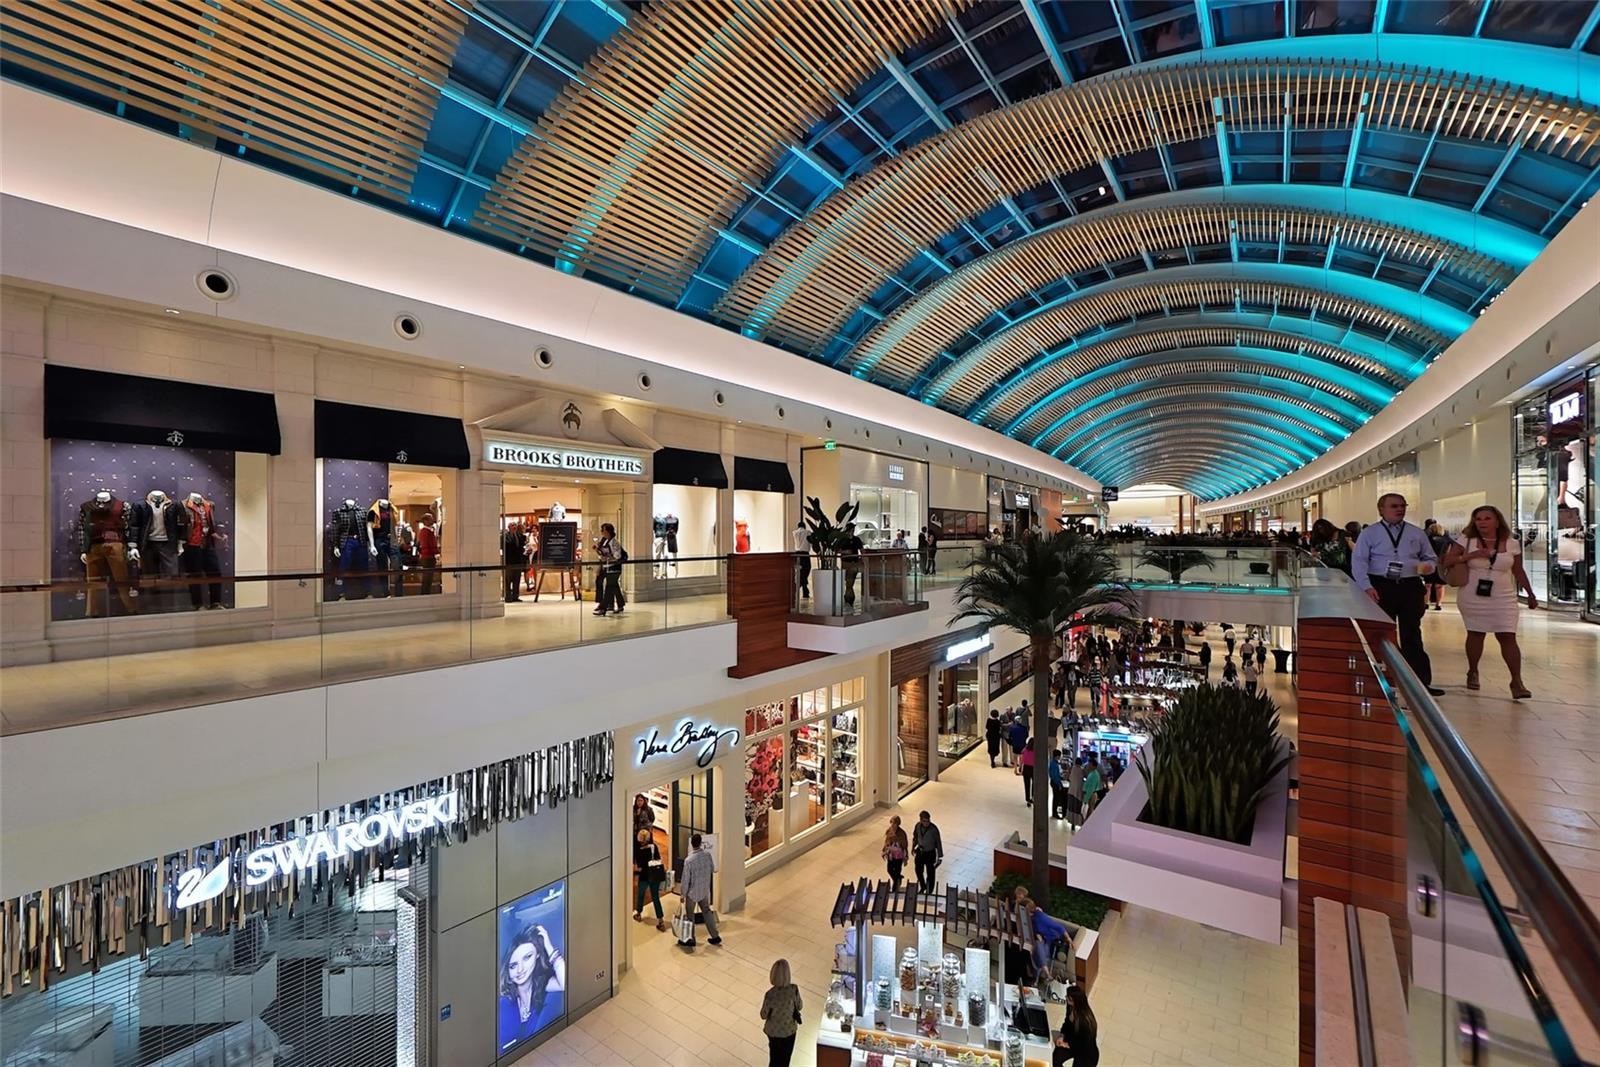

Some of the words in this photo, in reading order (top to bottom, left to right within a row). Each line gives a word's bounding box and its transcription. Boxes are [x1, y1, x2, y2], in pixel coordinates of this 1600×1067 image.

[494, 447, 561, 465] BROOKS
[566, 455, 642, 473] BROTHERS
[639, 730, 667, 763] Vera
[671, 721, 740, 767] Bradley
[245, 791, 458, 885] SWAROVSKI
